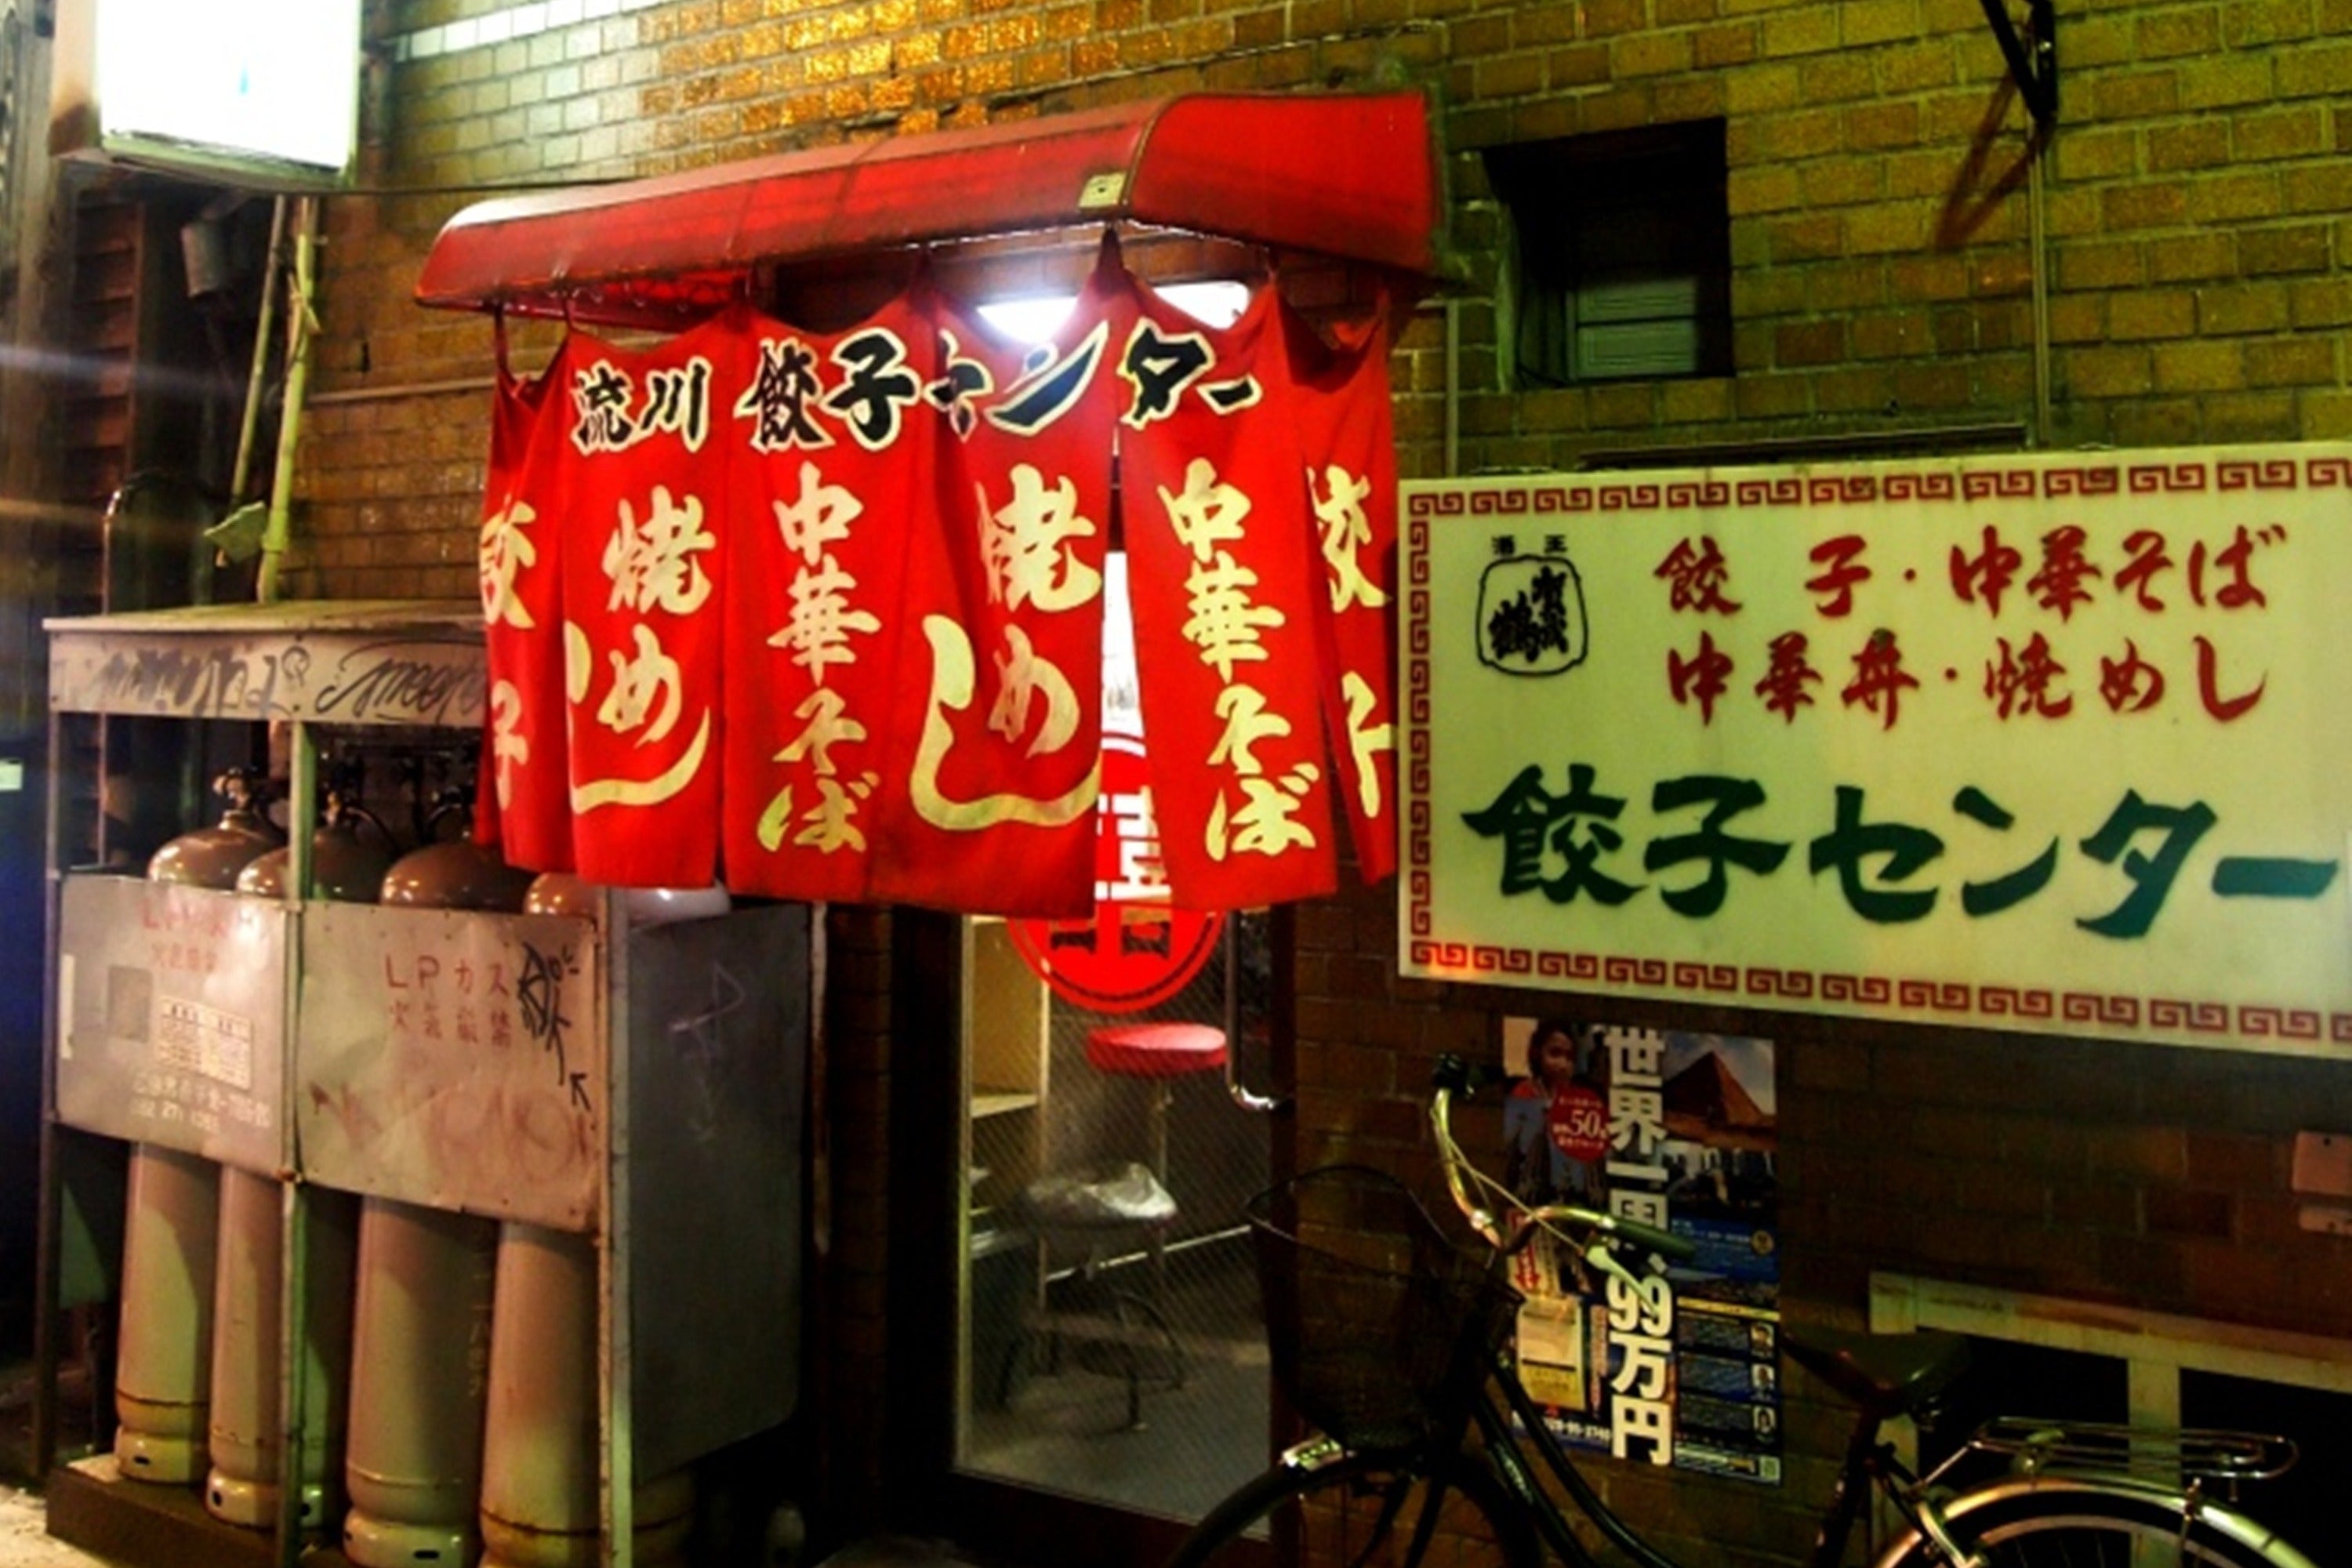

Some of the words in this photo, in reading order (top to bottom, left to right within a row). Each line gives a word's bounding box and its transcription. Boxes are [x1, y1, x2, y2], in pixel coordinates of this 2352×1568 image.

[757, 460, 881, 854] 中華そば
[1157, 457, 1321, 862] 中華そば
[1460, 763, 2339, 939] 餃子センター
